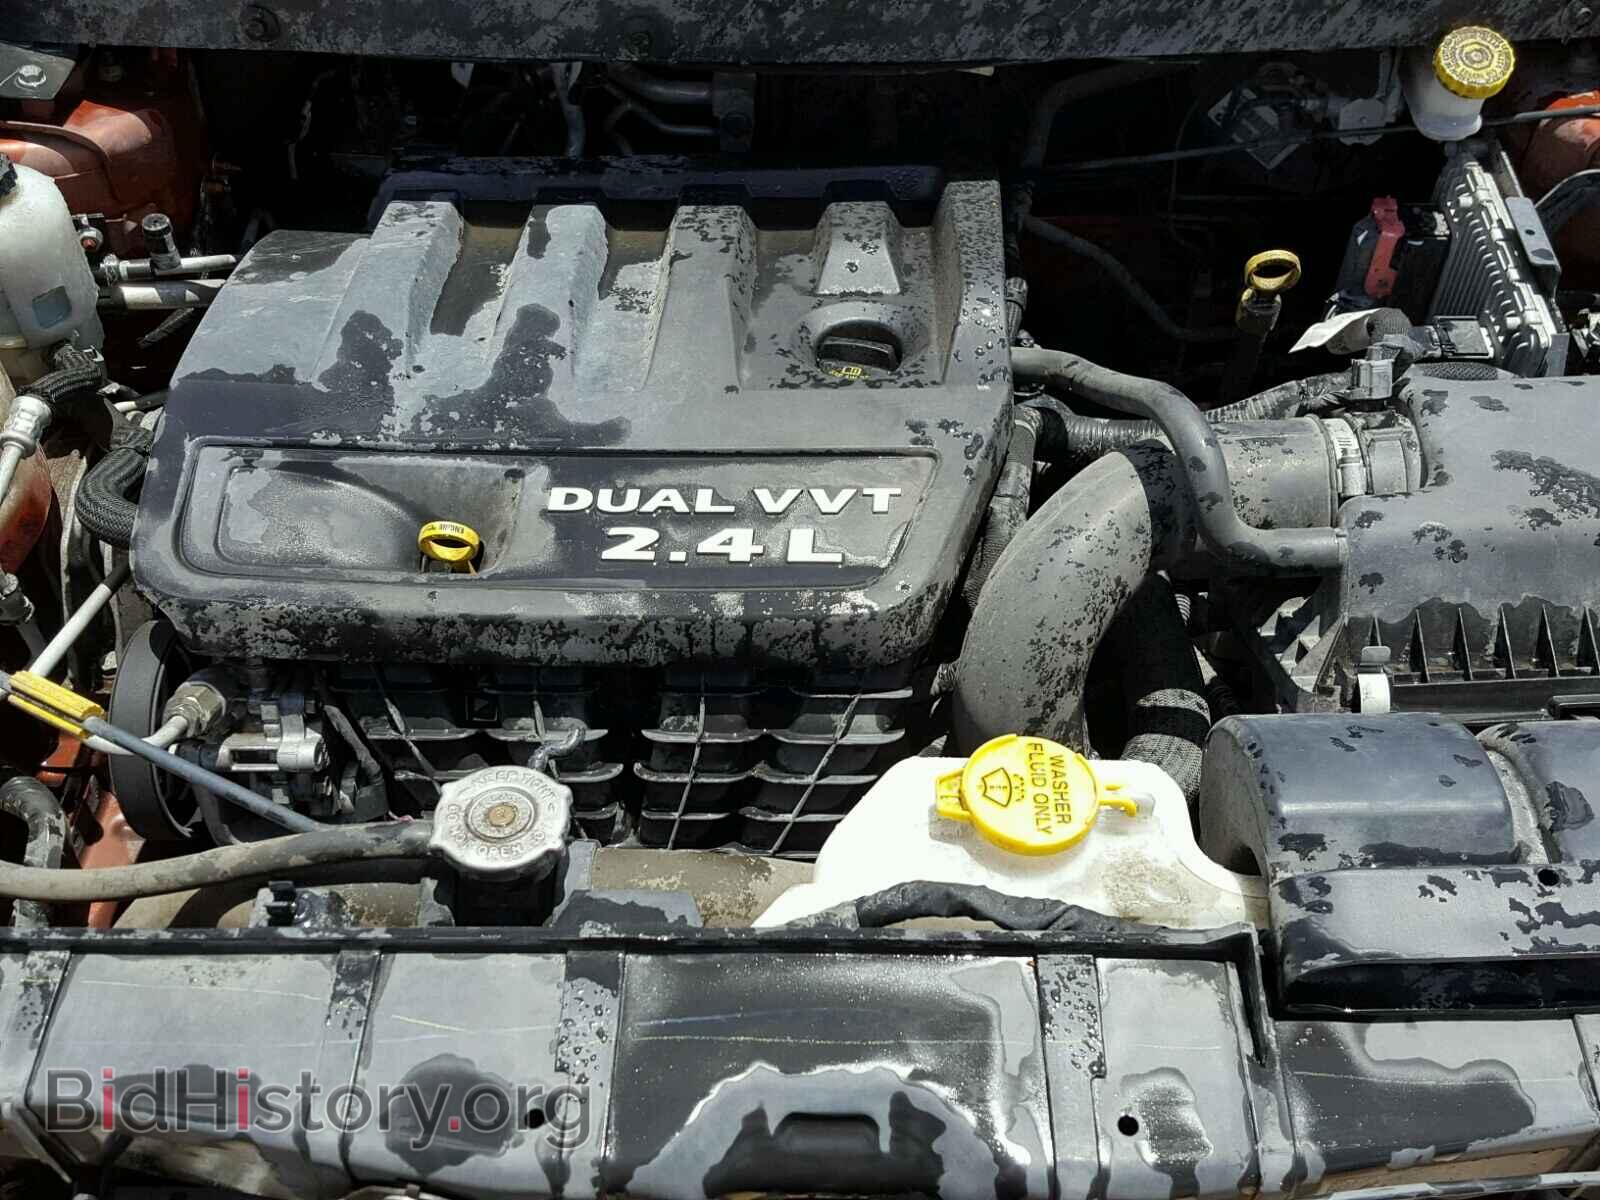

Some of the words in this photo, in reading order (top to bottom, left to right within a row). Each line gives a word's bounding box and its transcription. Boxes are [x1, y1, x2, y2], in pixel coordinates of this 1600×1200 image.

[547, 487, 736, 514] DUAL
[753, 487, 902, 514] VVT
[1026, 742, 1048, 789] FLUID
[1049, 754, 1073, 825] WASHER
[1032, 794, 1053, 836] ONLY
[477, 842, 523, 858] OPEN
